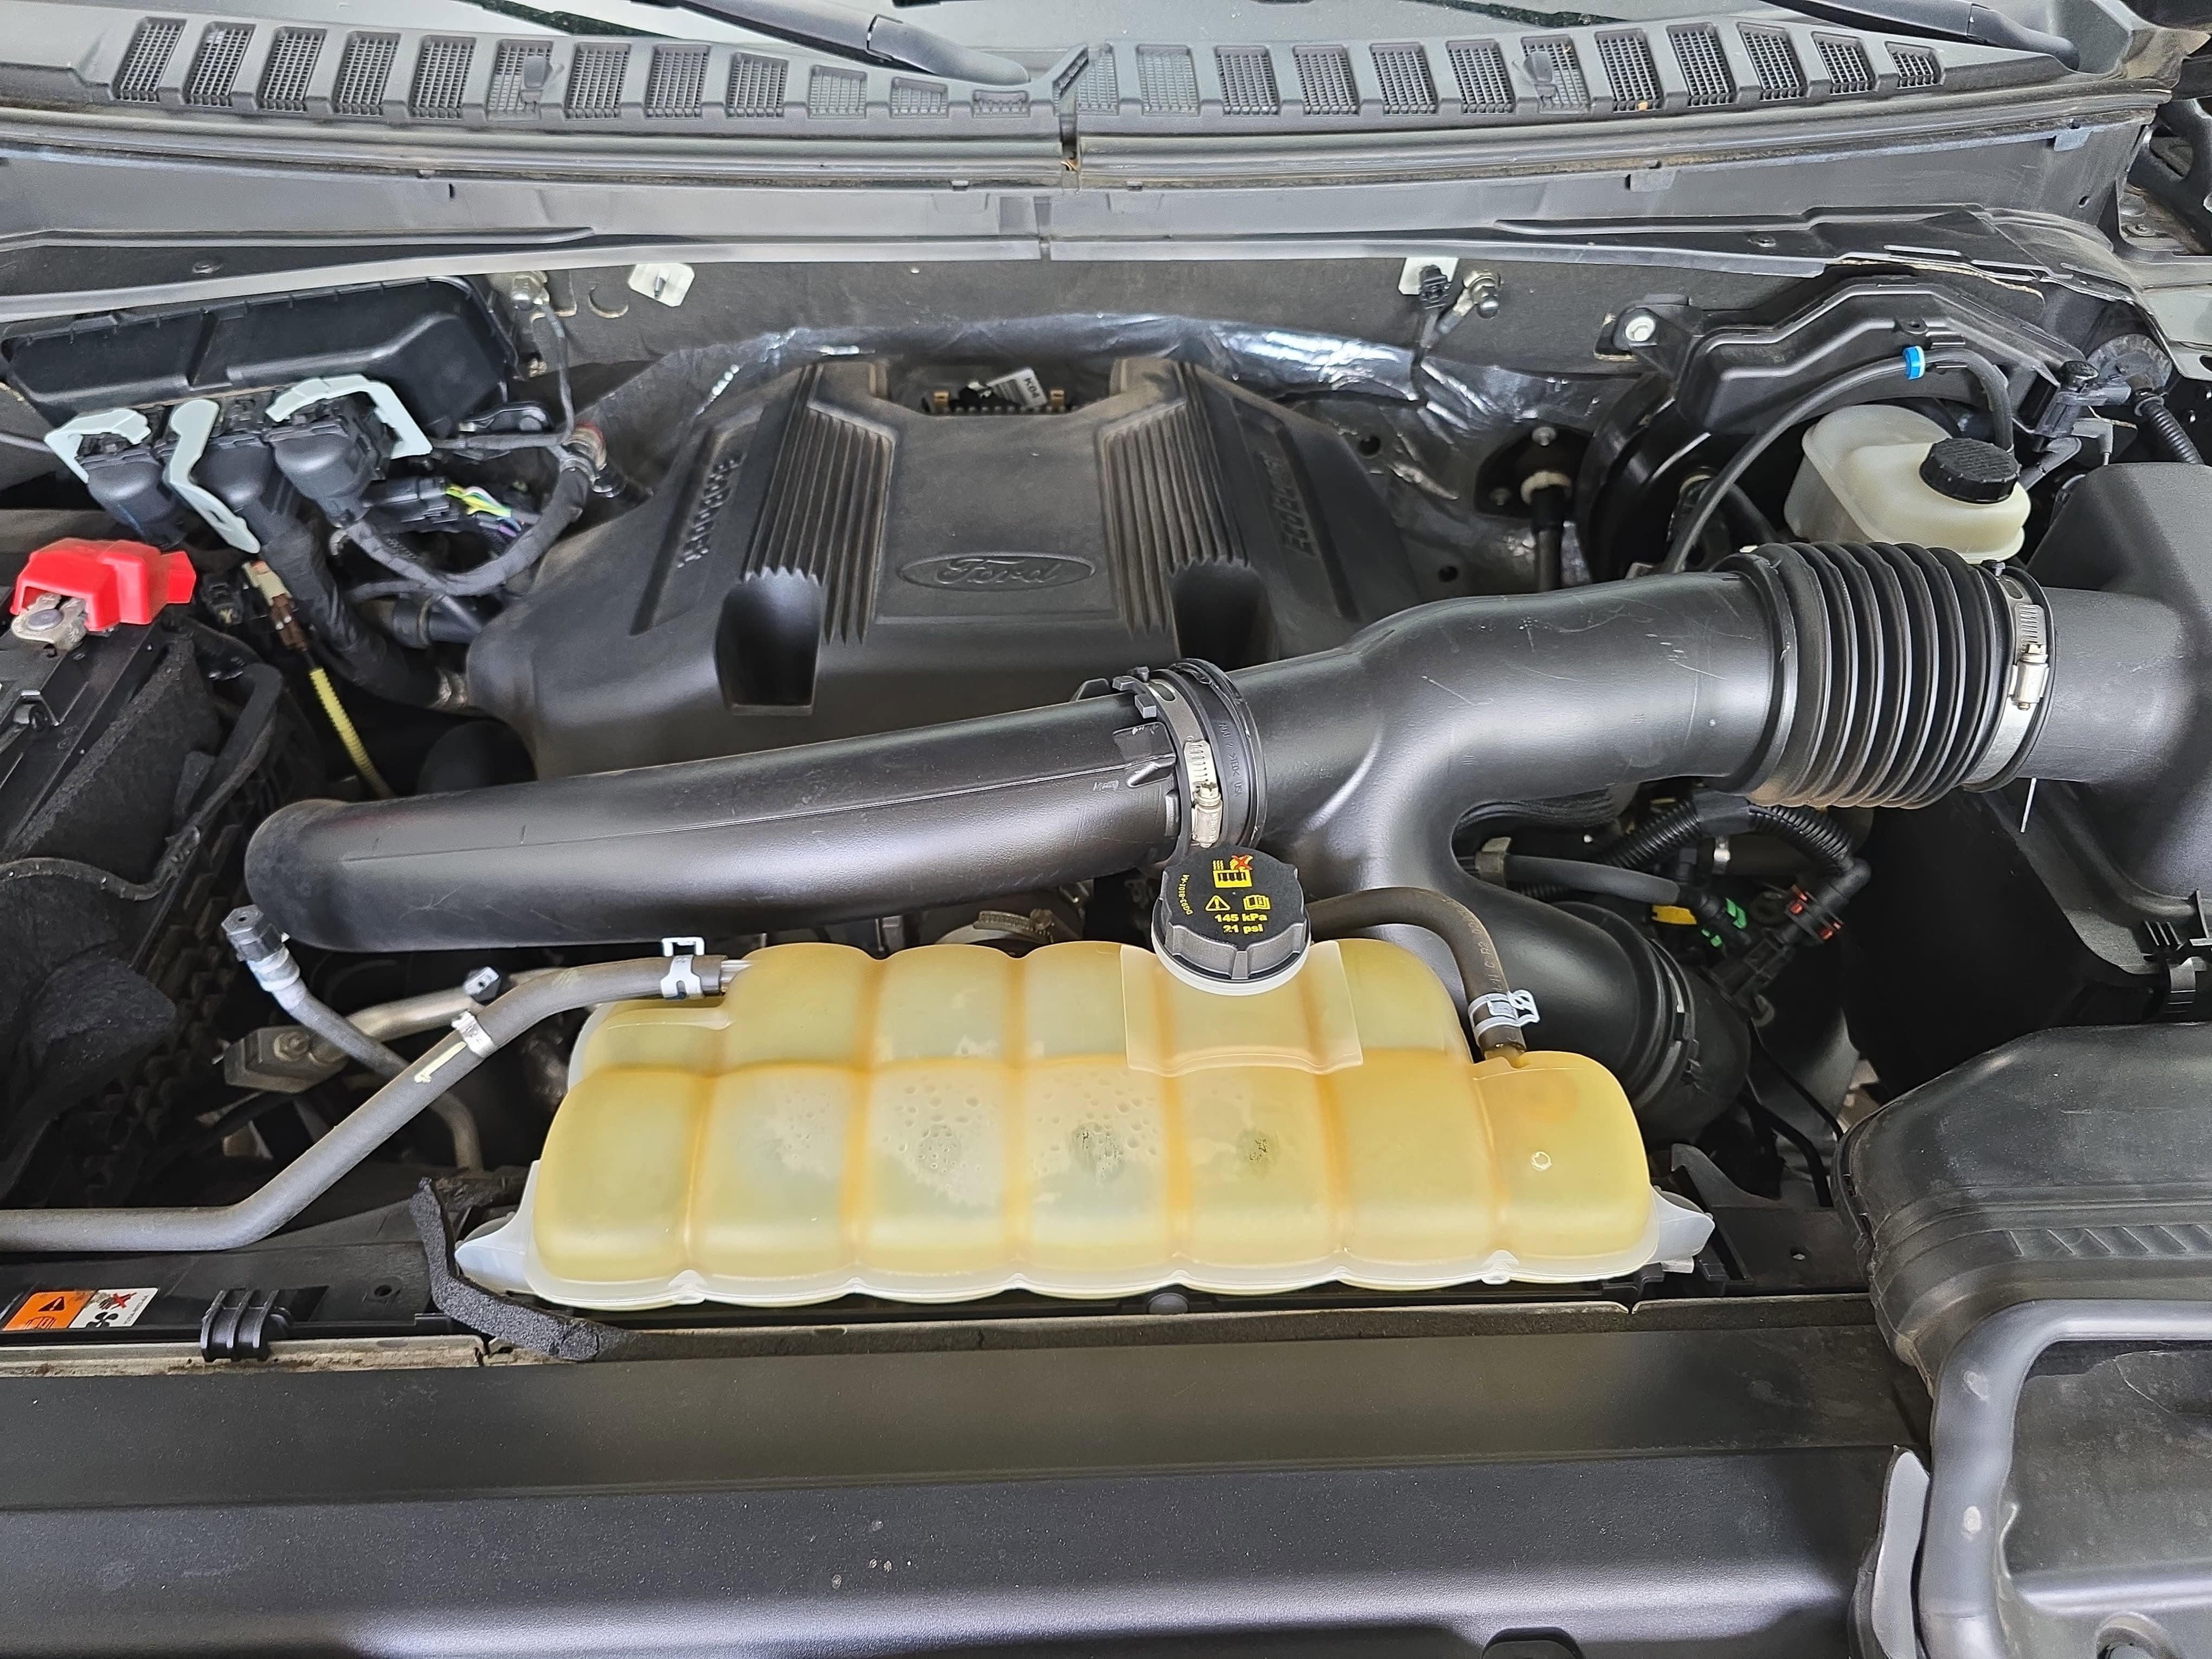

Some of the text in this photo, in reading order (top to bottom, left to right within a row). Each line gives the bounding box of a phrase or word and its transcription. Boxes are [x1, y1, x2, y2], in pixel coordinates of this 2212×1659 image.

[936, 558, 1062, 584] Ford
[1178, 874, 1193, 916] DG93-8101-AA
[1214, 913, 1269, 922] 145 kPa
[1223, 924, 1264, 934] 21 psi
